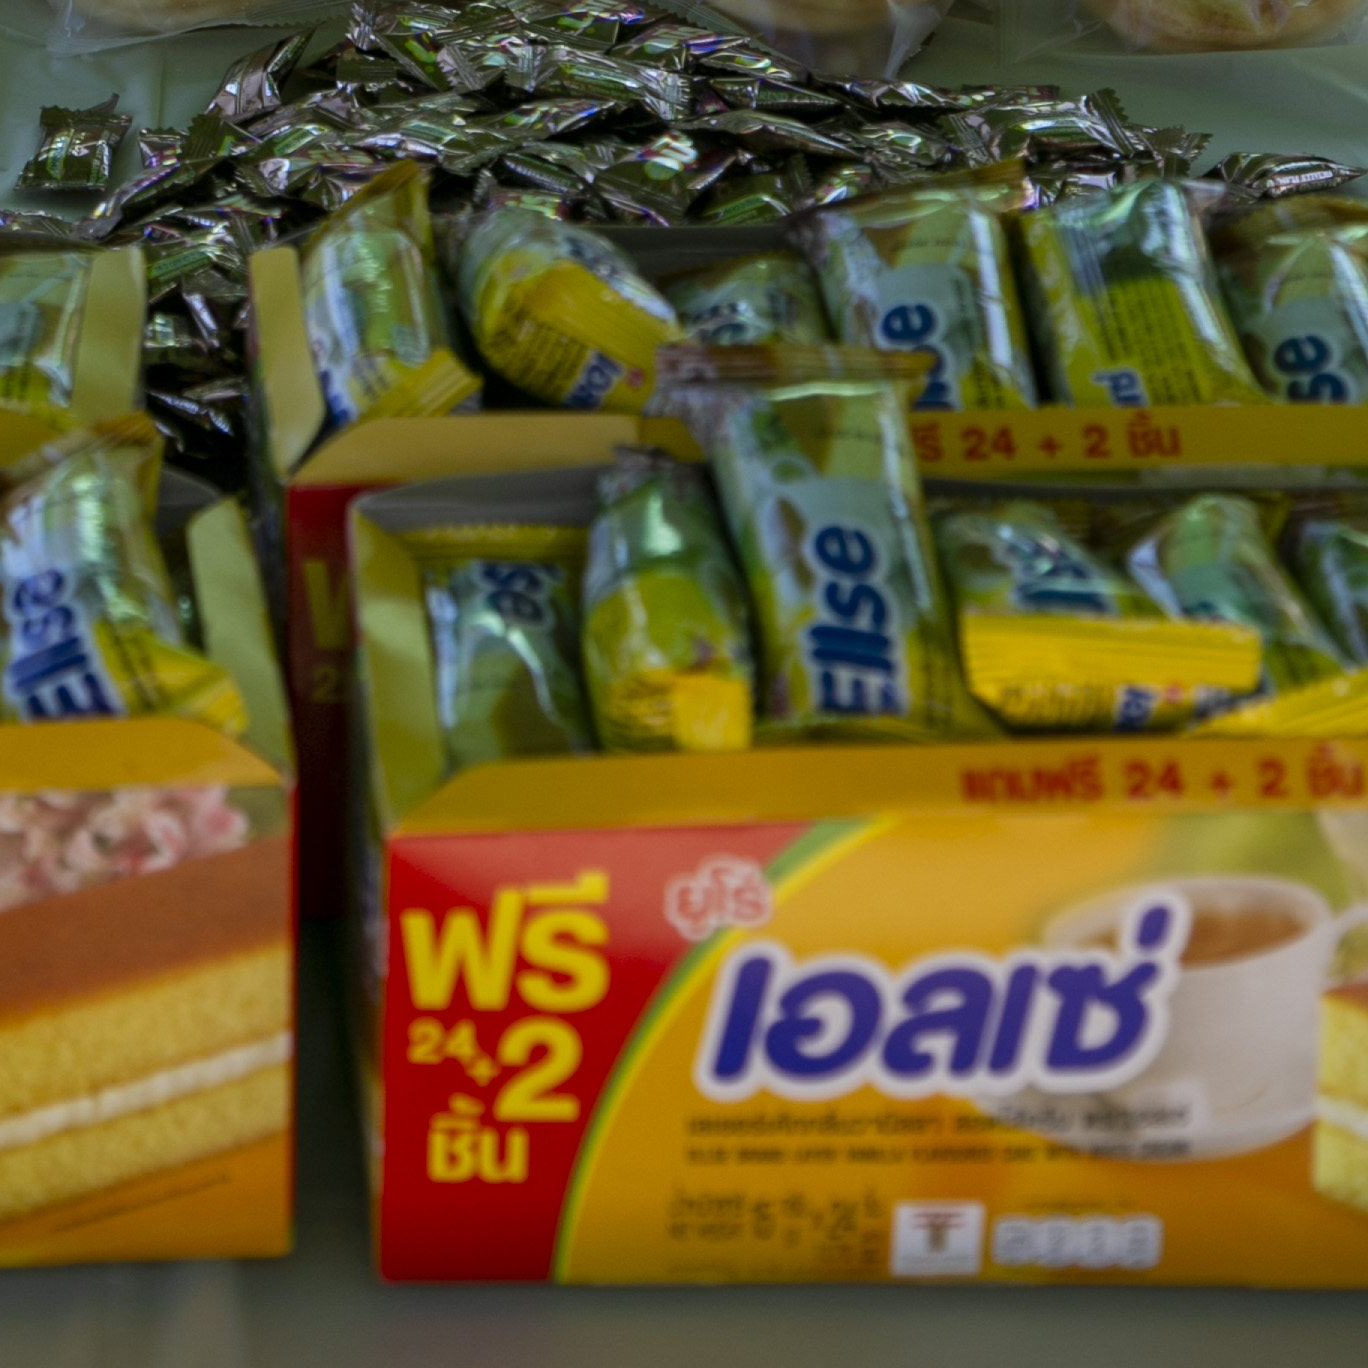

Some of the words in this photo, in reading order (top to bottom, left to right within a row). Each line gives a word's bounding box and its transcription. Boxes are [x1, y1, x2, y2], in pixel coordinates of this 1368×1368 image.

[961, 427, 1017, 460] 24
[1082, 425, 1110, 458] 2
[1123, 758, 1183, 801] 24
[1258, 758, 1287, 798] 2
[399, 869, 610, 1014] ฟรี
[709, 904, 1174, 1086] เอลเซ่
[427, 1092, 529, 1184] ชิ้น
